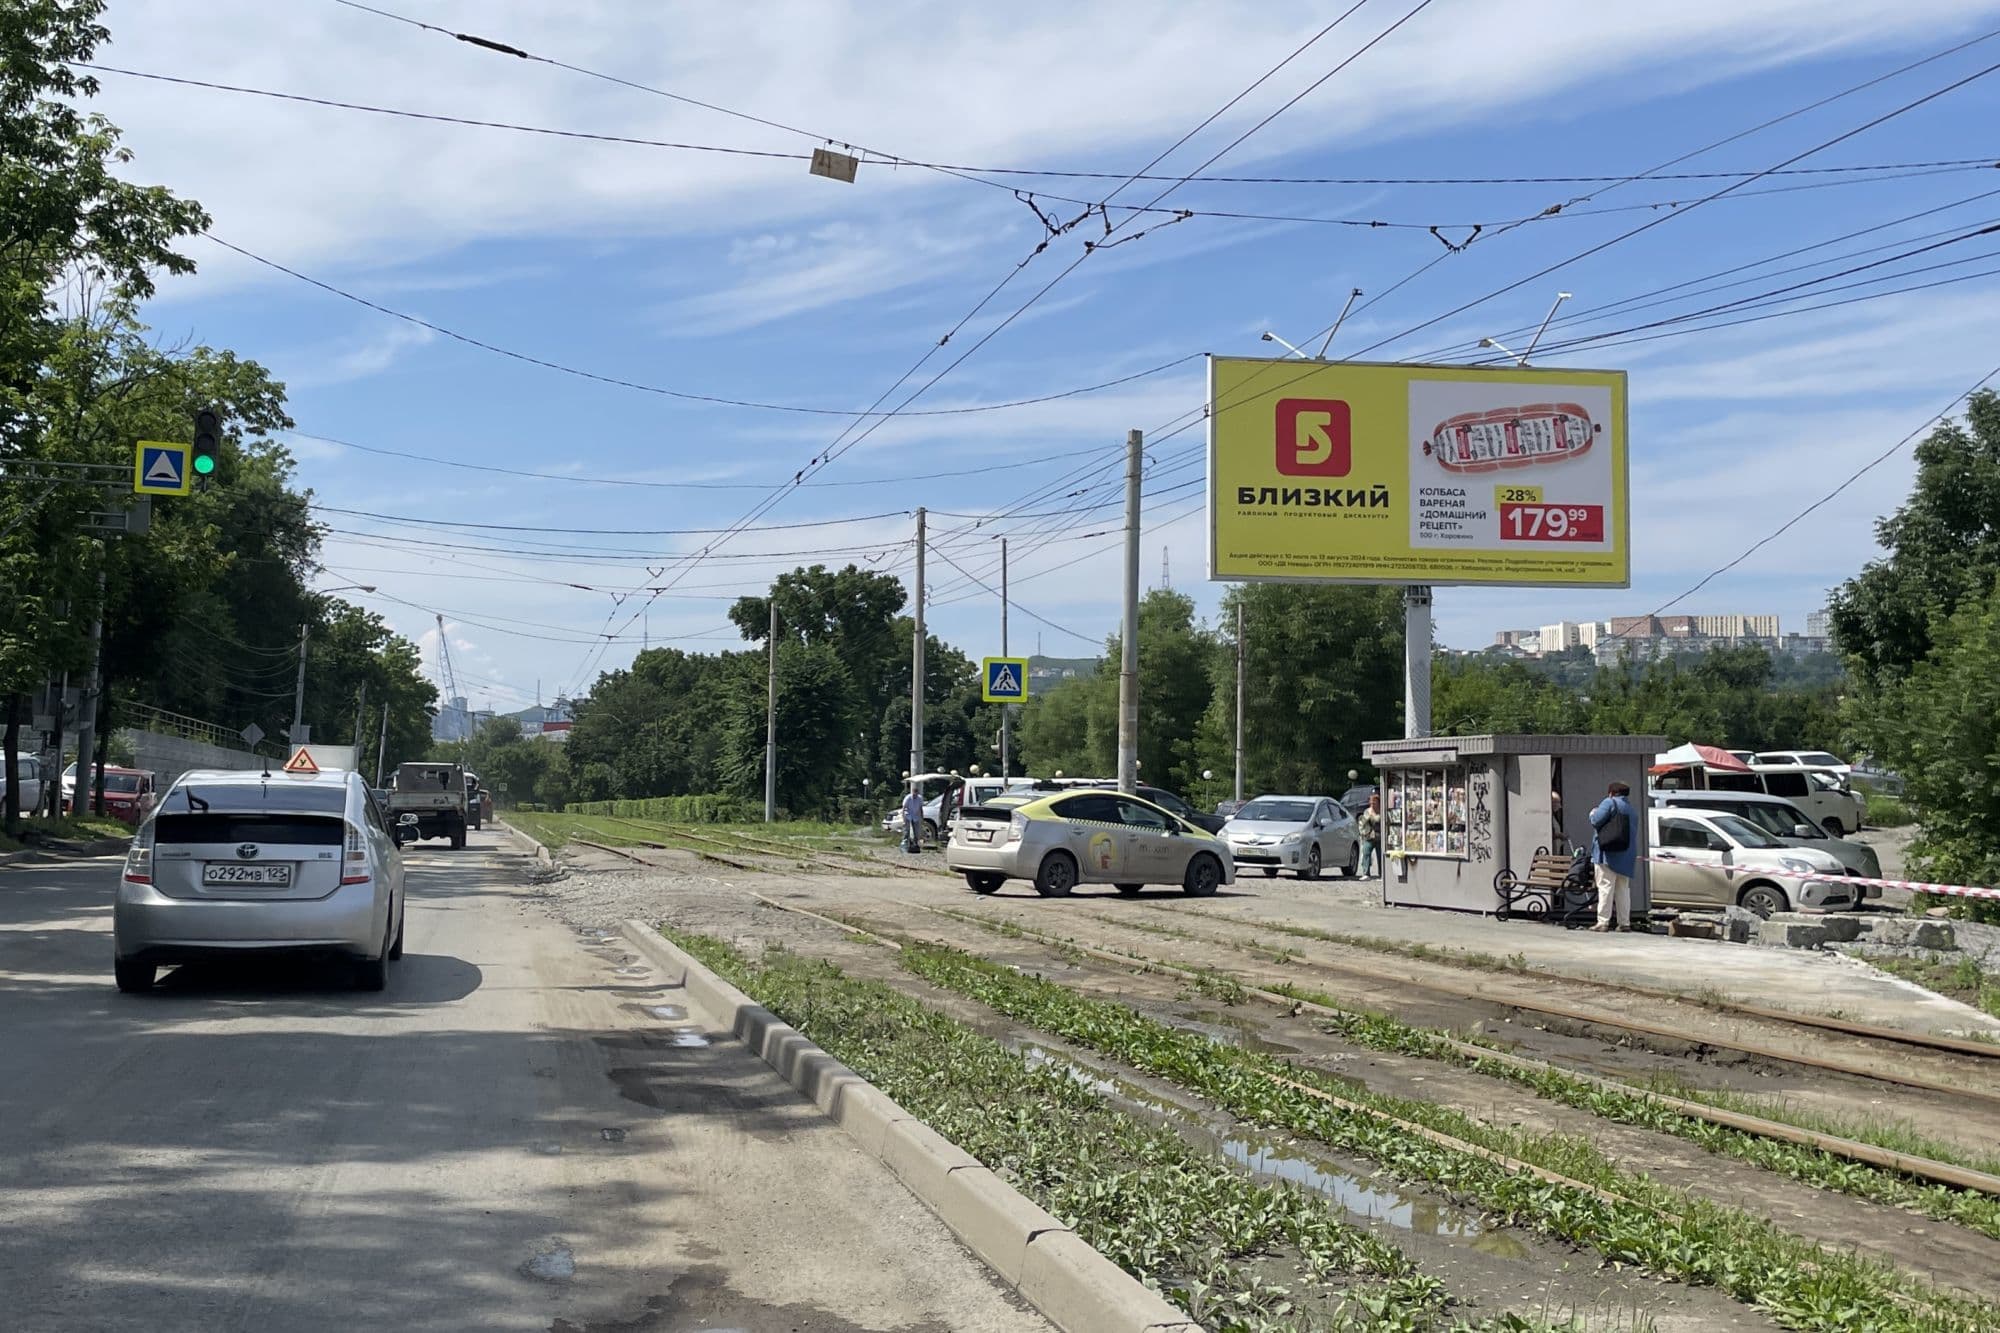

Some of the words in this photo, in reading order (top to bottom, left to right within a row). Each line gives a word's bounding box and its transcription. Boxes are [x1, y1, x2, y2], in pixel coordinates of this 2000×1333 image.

[1237, 484, 1390, 508] БЛИЗКИЙ
[1419, 487, 1466, 497] КОЛБАСА
[1501, 489, 1537, 502] -28%
[1419, 498, 1466, 508] ВАРЕНАЯ
[1420, 509, 1487, 520] «ДОМАШНИЙ
[1420, 521, 1463, 531] РЕЦЕПТ»
[1508, 507, 1568, 537] 179
